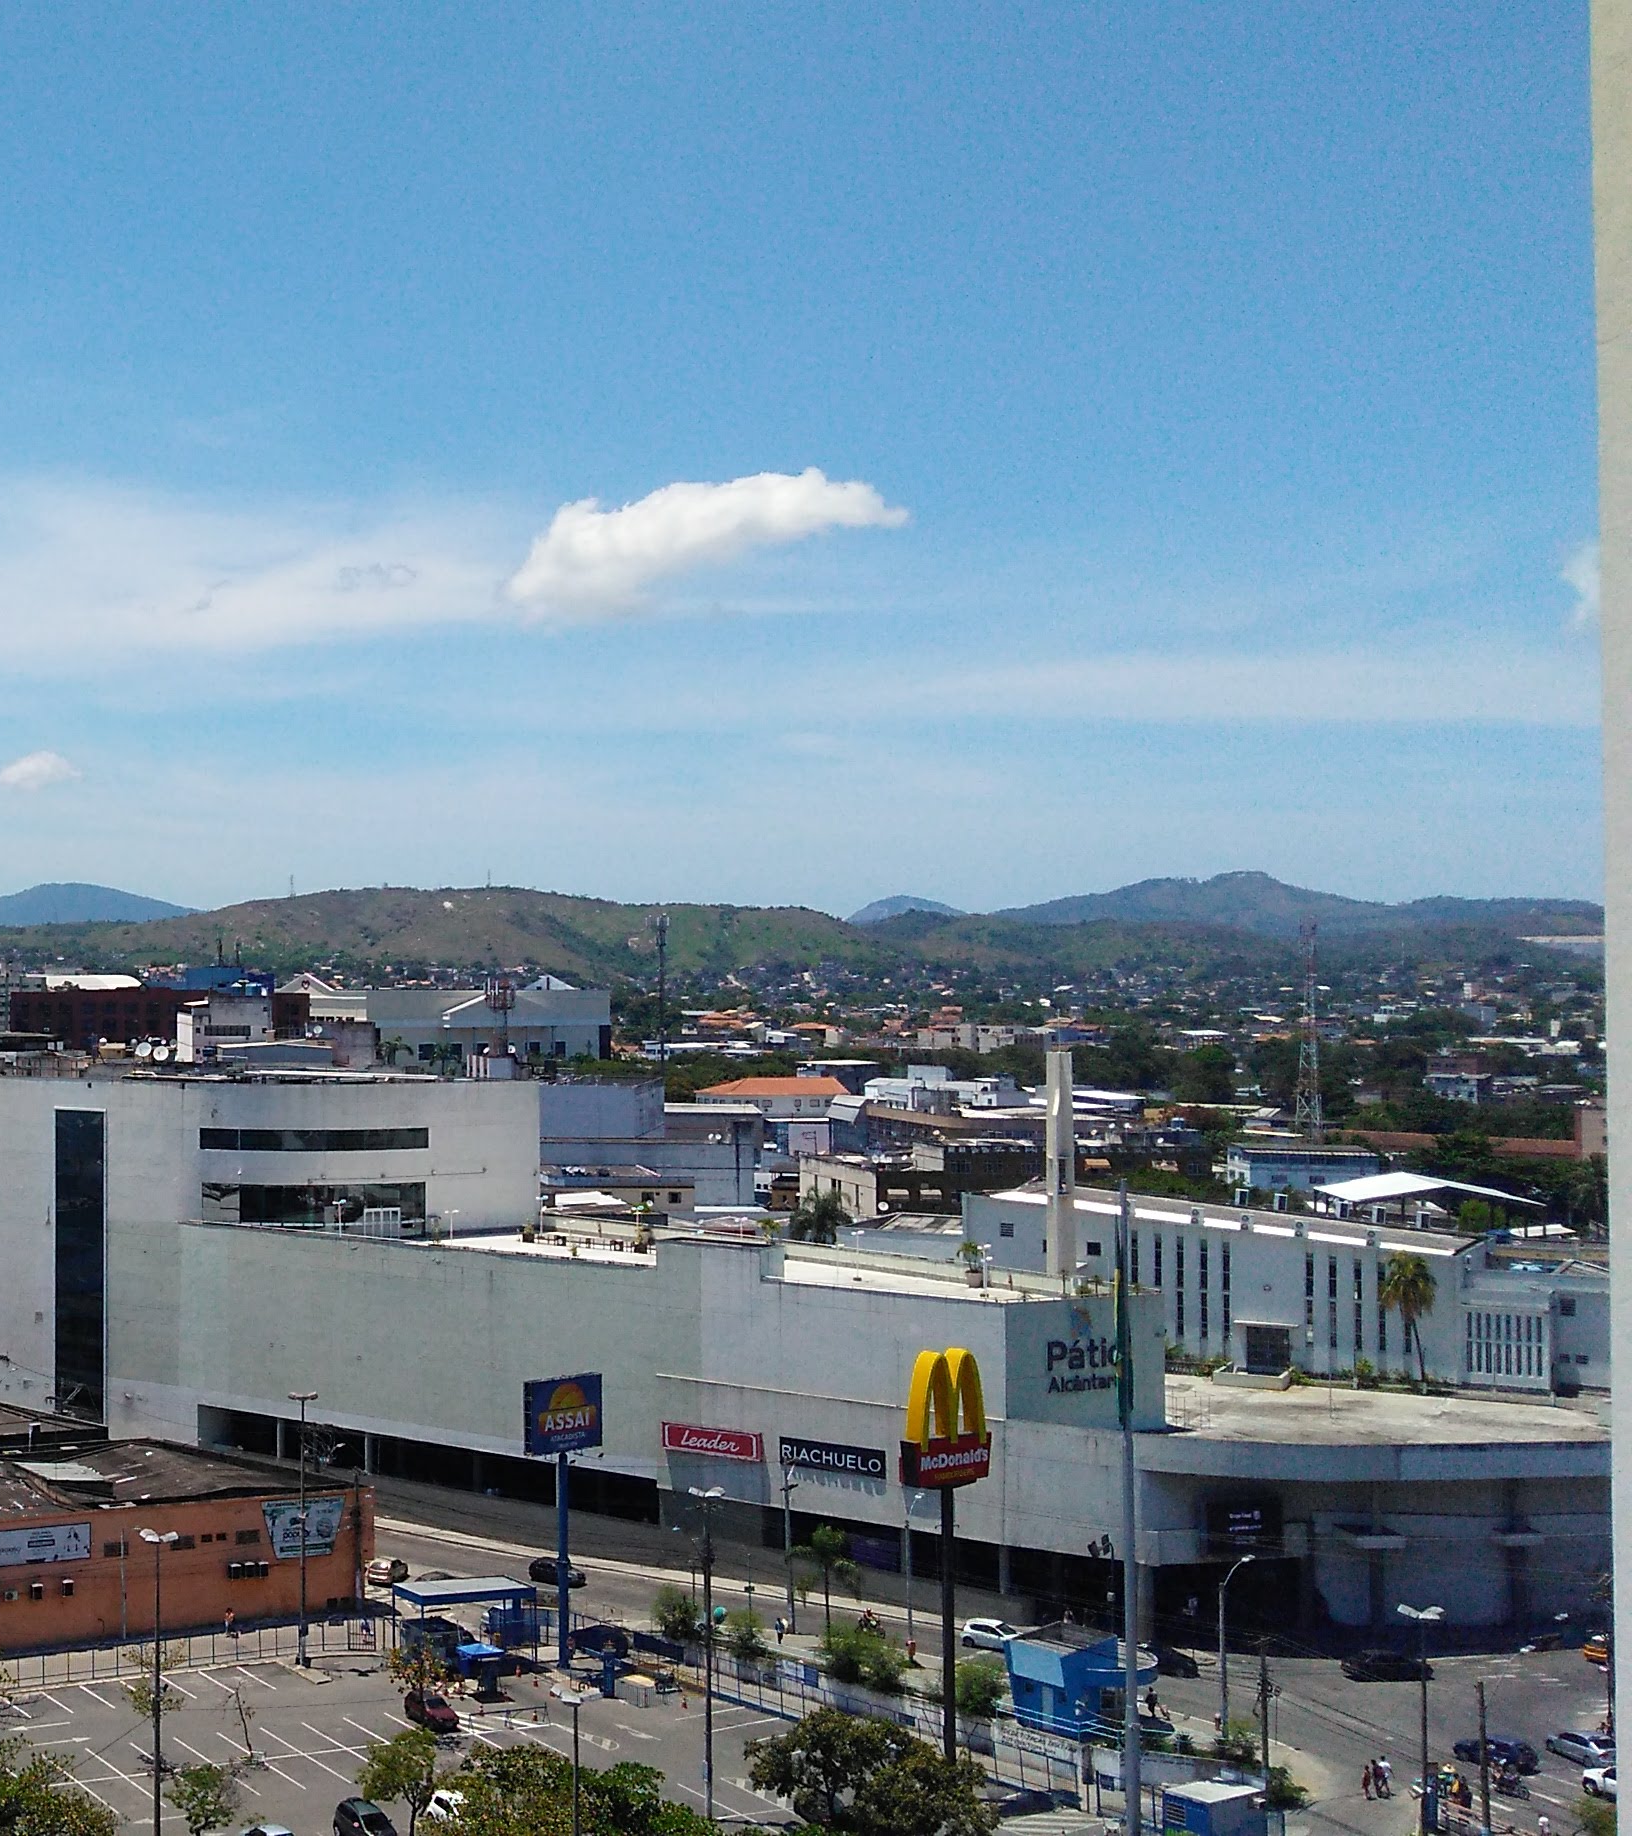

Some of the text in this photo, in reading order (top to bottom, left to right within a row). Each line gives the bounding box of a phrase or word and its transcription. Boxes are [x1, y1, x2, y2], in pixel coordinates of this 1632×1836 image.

[1048, 1373, 1117, 1393] Alcântar
[544, 1407, 590, 1432] ASSAÍ
[681, 1429, 740, 1452] Leader
[781, 1444, 882, 1472] RIACHUELO
[920, 1447, 988, 1472] McDonald's
